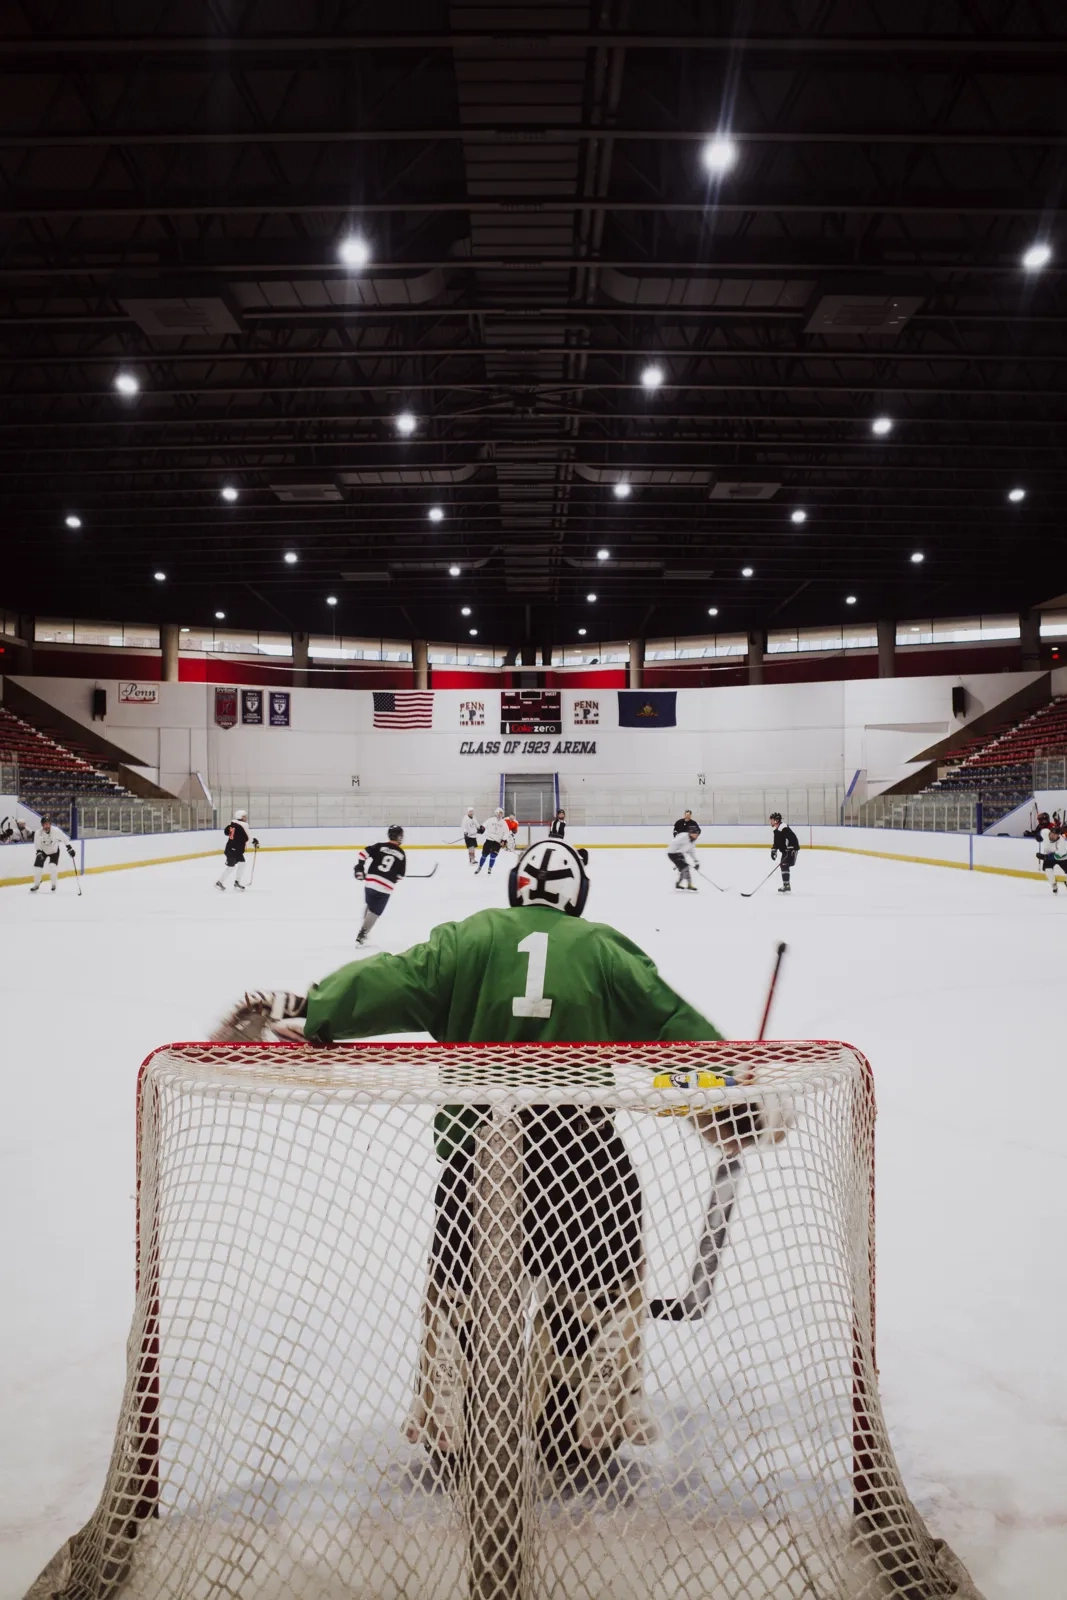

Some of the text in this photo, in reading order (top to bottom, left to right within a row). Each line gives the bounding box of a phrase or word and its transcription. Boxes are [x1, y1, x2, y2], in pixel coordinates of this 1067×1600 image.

[122, 683, 156, 697] Penn
[460, 701, 484, 712] PENN
[574, 700, 599, 711] PENN
[469, 710, 476, 720] P
[583, 709, 591, 719] P
[511, 724, 533, 732] Coke
[459, 741, 597, 754] CLASS OF 1923 ARENA
[378, 855, 395, 872] 9
[512, 931, 552, 1018] 1
